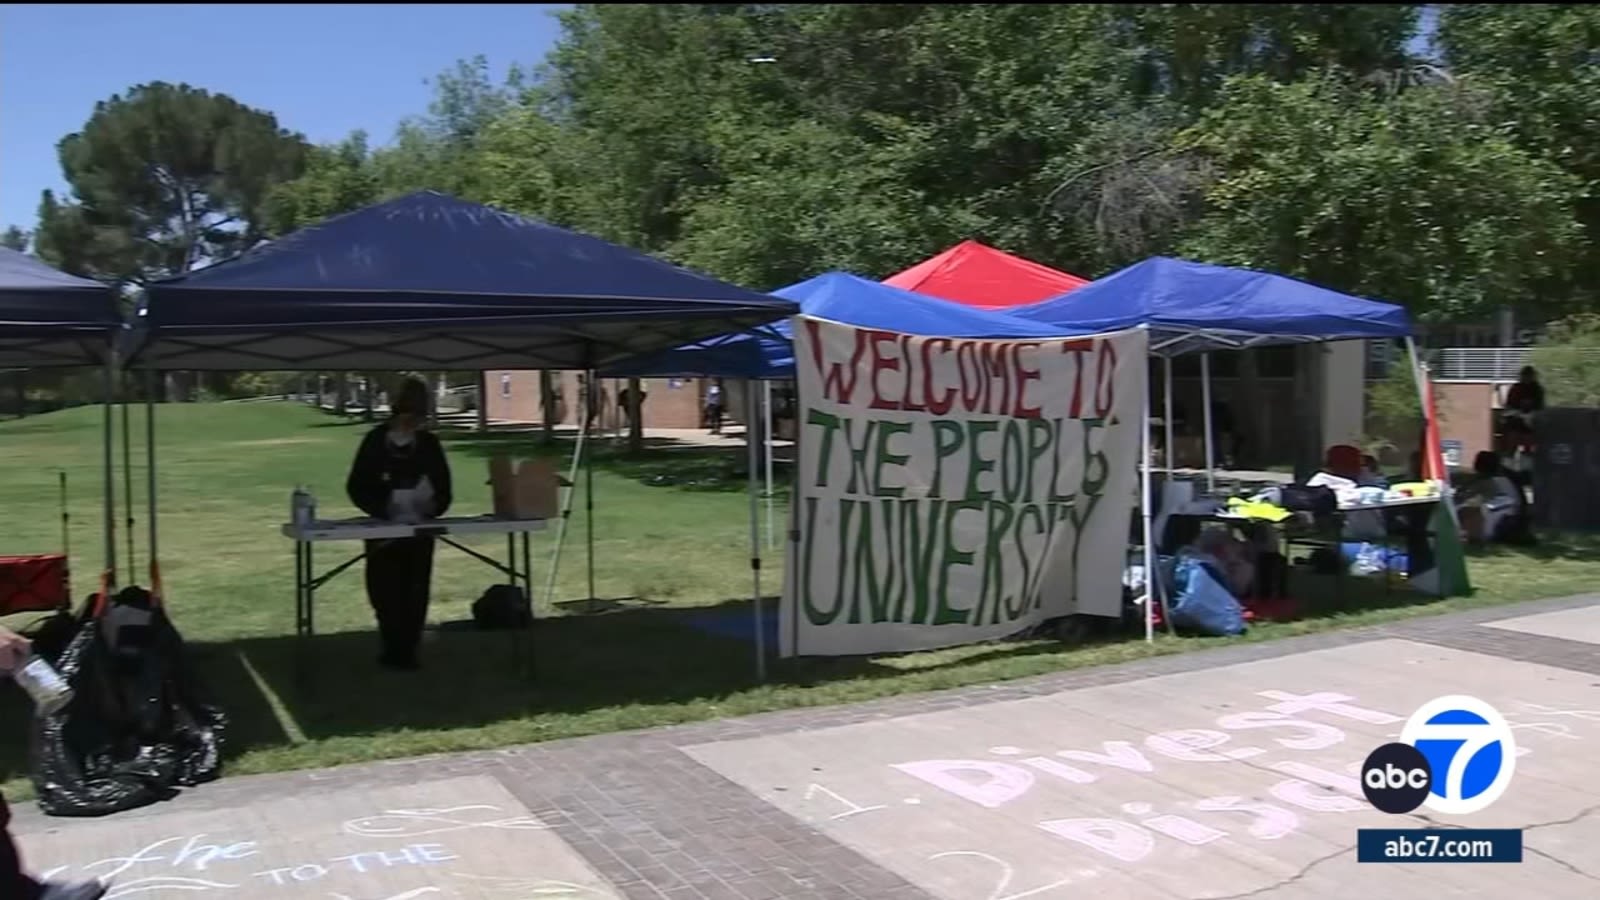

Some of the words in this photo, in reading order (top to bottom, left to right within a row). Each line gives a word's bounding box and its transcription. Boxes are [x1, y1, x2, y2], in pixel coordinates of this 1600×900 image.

[805, 320, 1042, 419] WELCOME
[1062, 339, 1116, 418] TO
[807, 408, 913, 498] THE
[888, 690, 1405, 808] Divest
[253, 864, 331, 885] TO
[329, 843, 460, 872] THE
